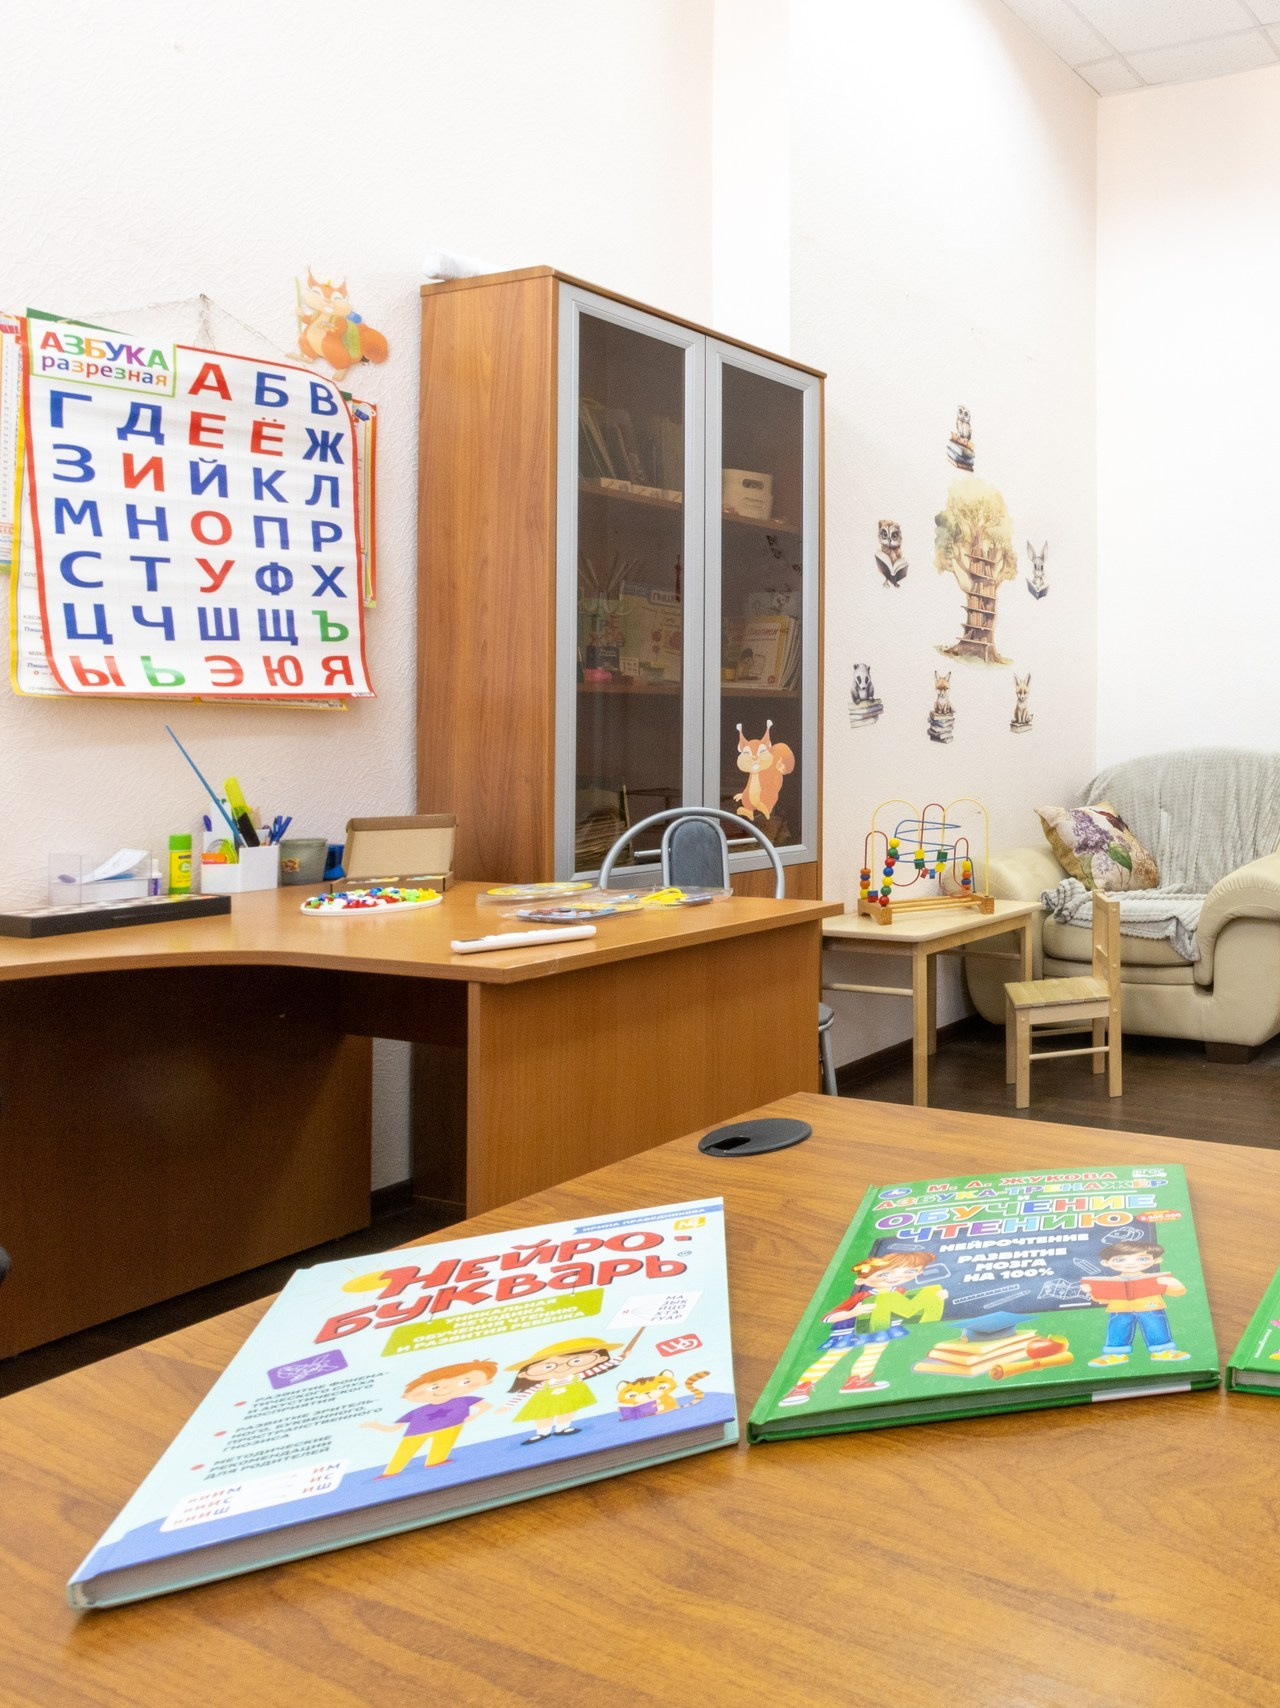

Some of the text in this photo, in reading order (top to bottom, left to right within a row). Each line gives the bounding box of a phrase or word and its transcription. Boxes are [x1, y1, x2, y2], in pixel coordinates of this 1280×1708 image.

[40, 331, 169, 371] АЗБУКА
[42, 356, 168, 386] разрезная
[188, 362, 339, 416] А Б В
[50, 390, 345, 465] Г Д Е Ё Ж
[53, 444, 340, 508] З И Й К Л
[54, 498, 343, 552] М Н О П Р
[59, 551, 348, 598] С Т У Ф Х
[62, 603, 349, 645] Ц Ч Ш Щ Ъ
[70, 655, 354, 687] Ы Ь Э Ю Я
[999, 1172, 1117, 1185] ЖУКОВА
[582, 1222, 620, 1232] ИРИНА
[875, 1194, 1157, 1229] ОБУЧЕНИЕ
[896, 1211, 1133, 1242] ЧТЕНИЮ
[939, 1232, 1089, 1252] НЕЙРОЧТЕНИЕ
[957, 1247, 1068, 1264] РАЗВИТИЕ
[963, 1267, 1055, 1283] НА 100%
[975, 1258, 1049, 1272] МОЗГА
[412, 1306, 578, 1343] ОБУЧЕНИЯ ЧТЕНИЮ
[445, 1298, 557, 1324] УНИКАЛЬНАЯ
[454, 1307, 544, 1329] МЕТОДИКА
[414, 1326, 507, 1349] РАЗВИТИЯ
